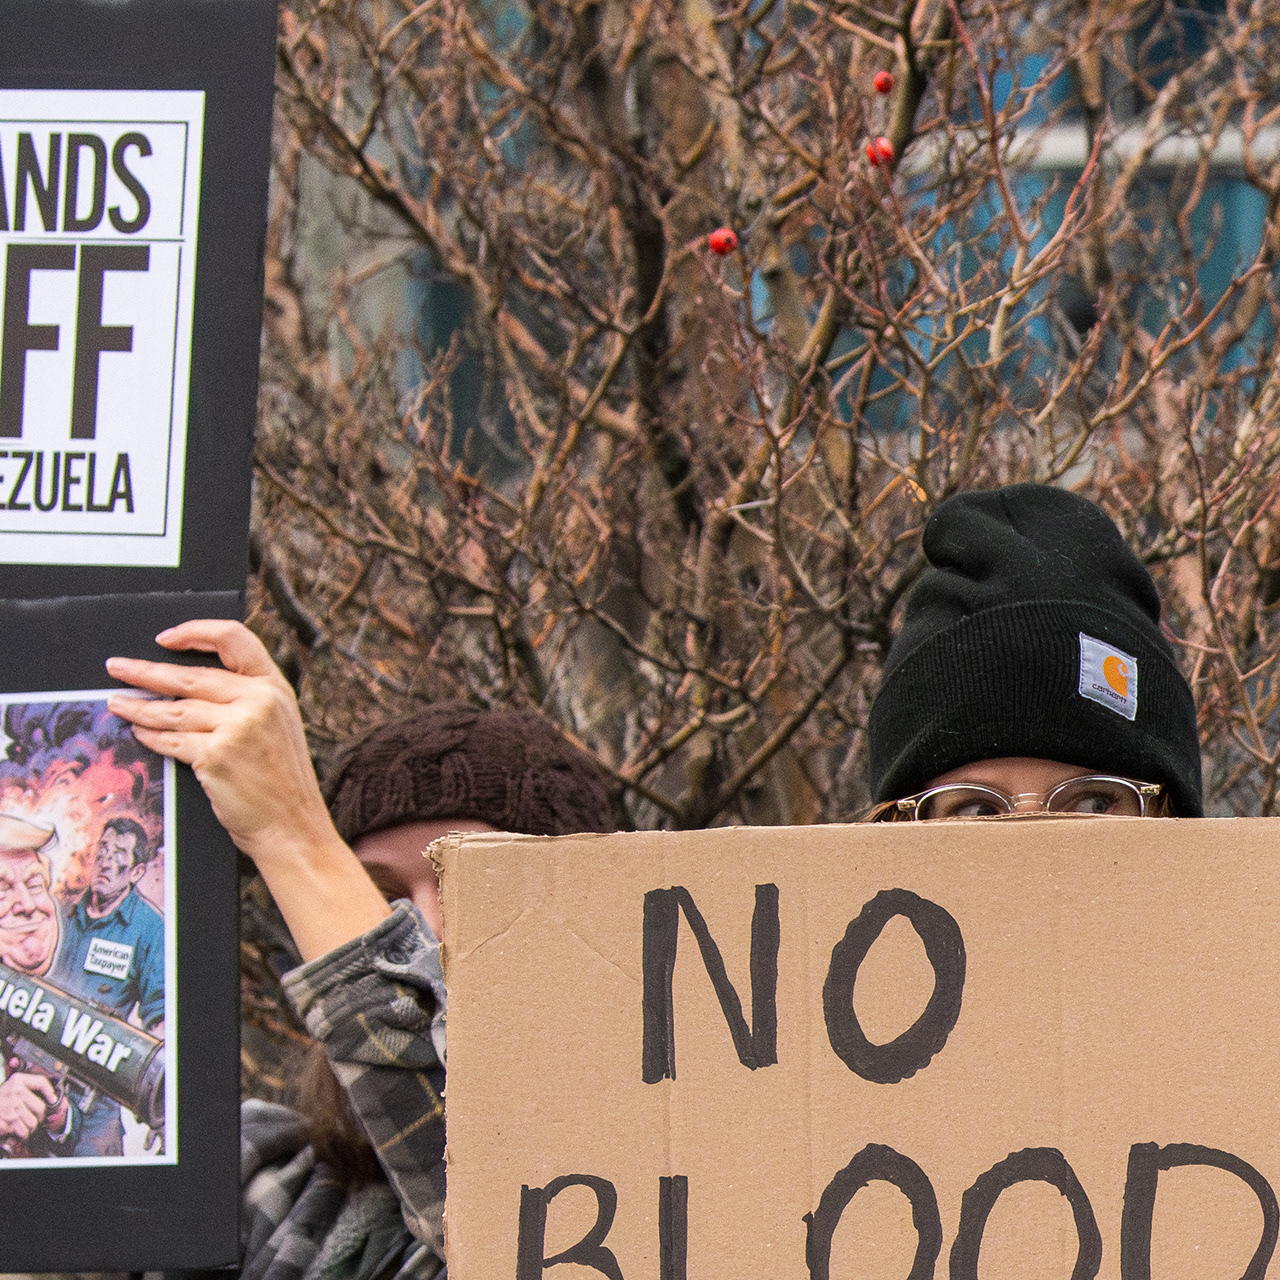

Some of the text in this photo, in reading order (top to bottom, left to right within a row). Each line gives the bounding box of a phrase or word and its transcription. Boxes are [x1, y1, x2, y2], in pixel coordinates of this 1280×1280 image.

[0, 132, 152, 234] NDS
[641, 883, 966, 1084] NO
[60, 1007, 132, 1073] War
